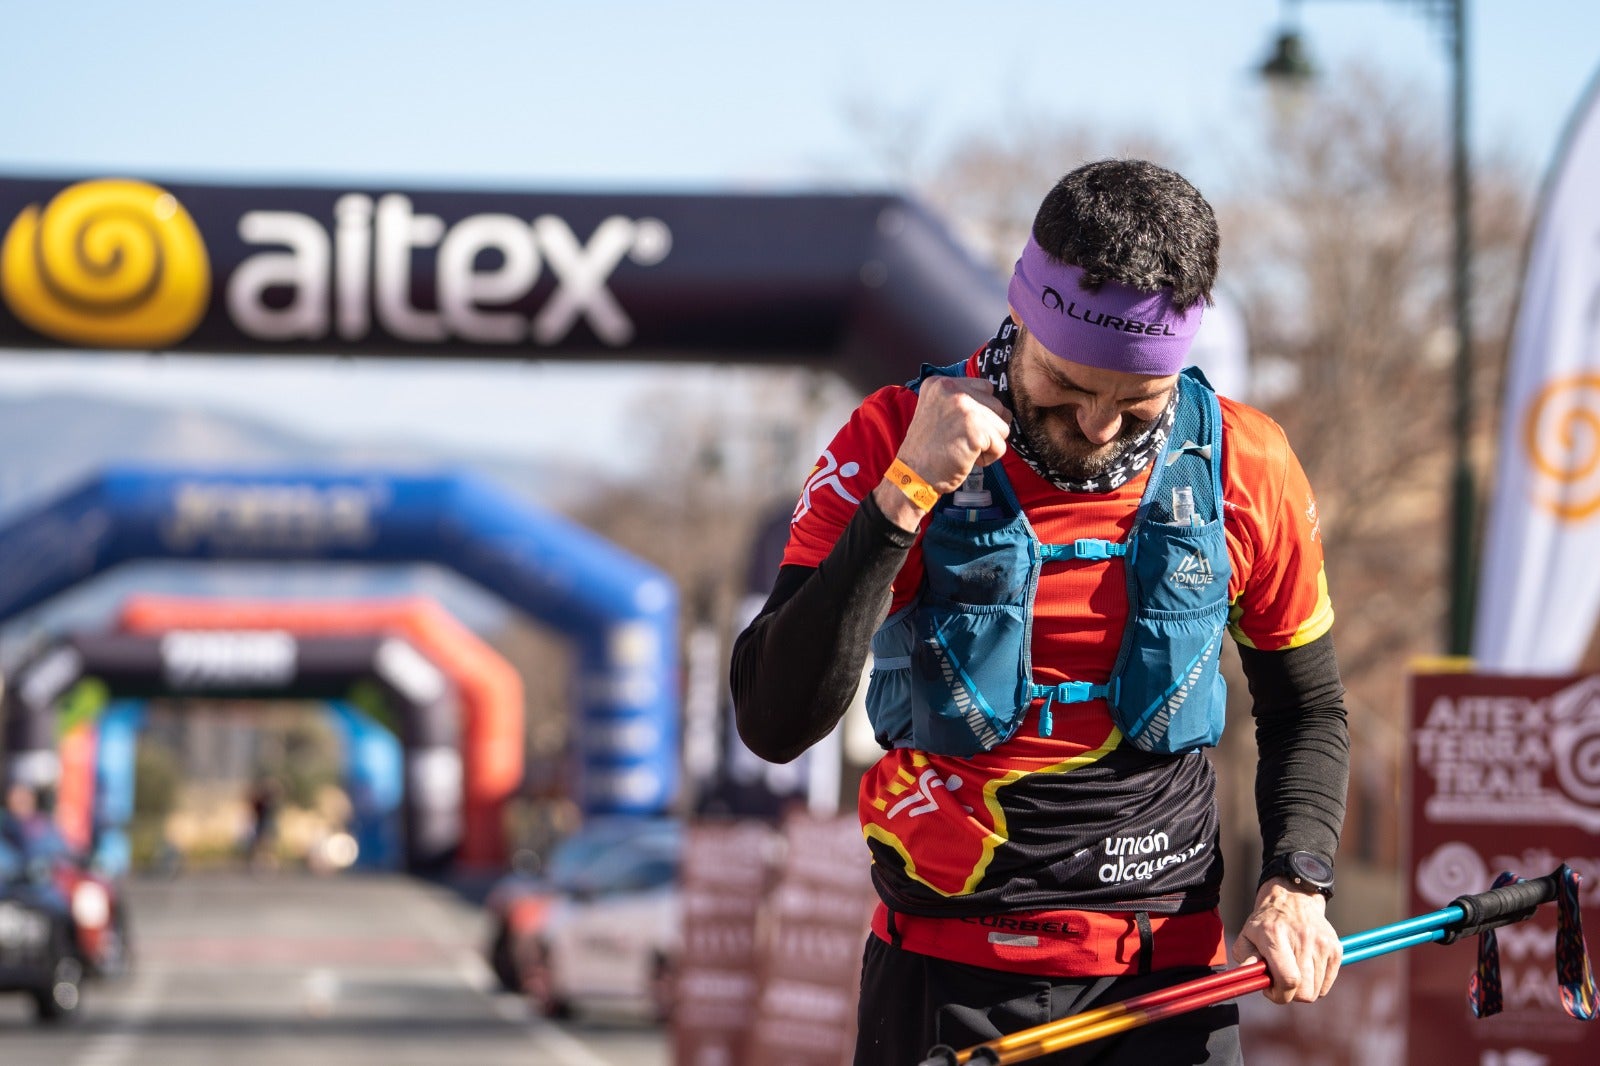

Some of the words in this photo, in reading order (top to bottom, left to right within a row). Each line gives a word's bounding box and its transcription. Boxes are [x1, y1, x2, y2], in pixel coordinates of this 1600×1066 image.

[227, 192, 635, 346] aitex
[1066, 302, 1176, 337] LURBEL
[1169, 571, 1214, 584] AONIJE
[1423, 696, 1553, 733] AITEX
[1415, 728, 1554, 768] TERRA
[1104, 828, 1169, 856] unión
[1098, 842, 1207, 883] alco
